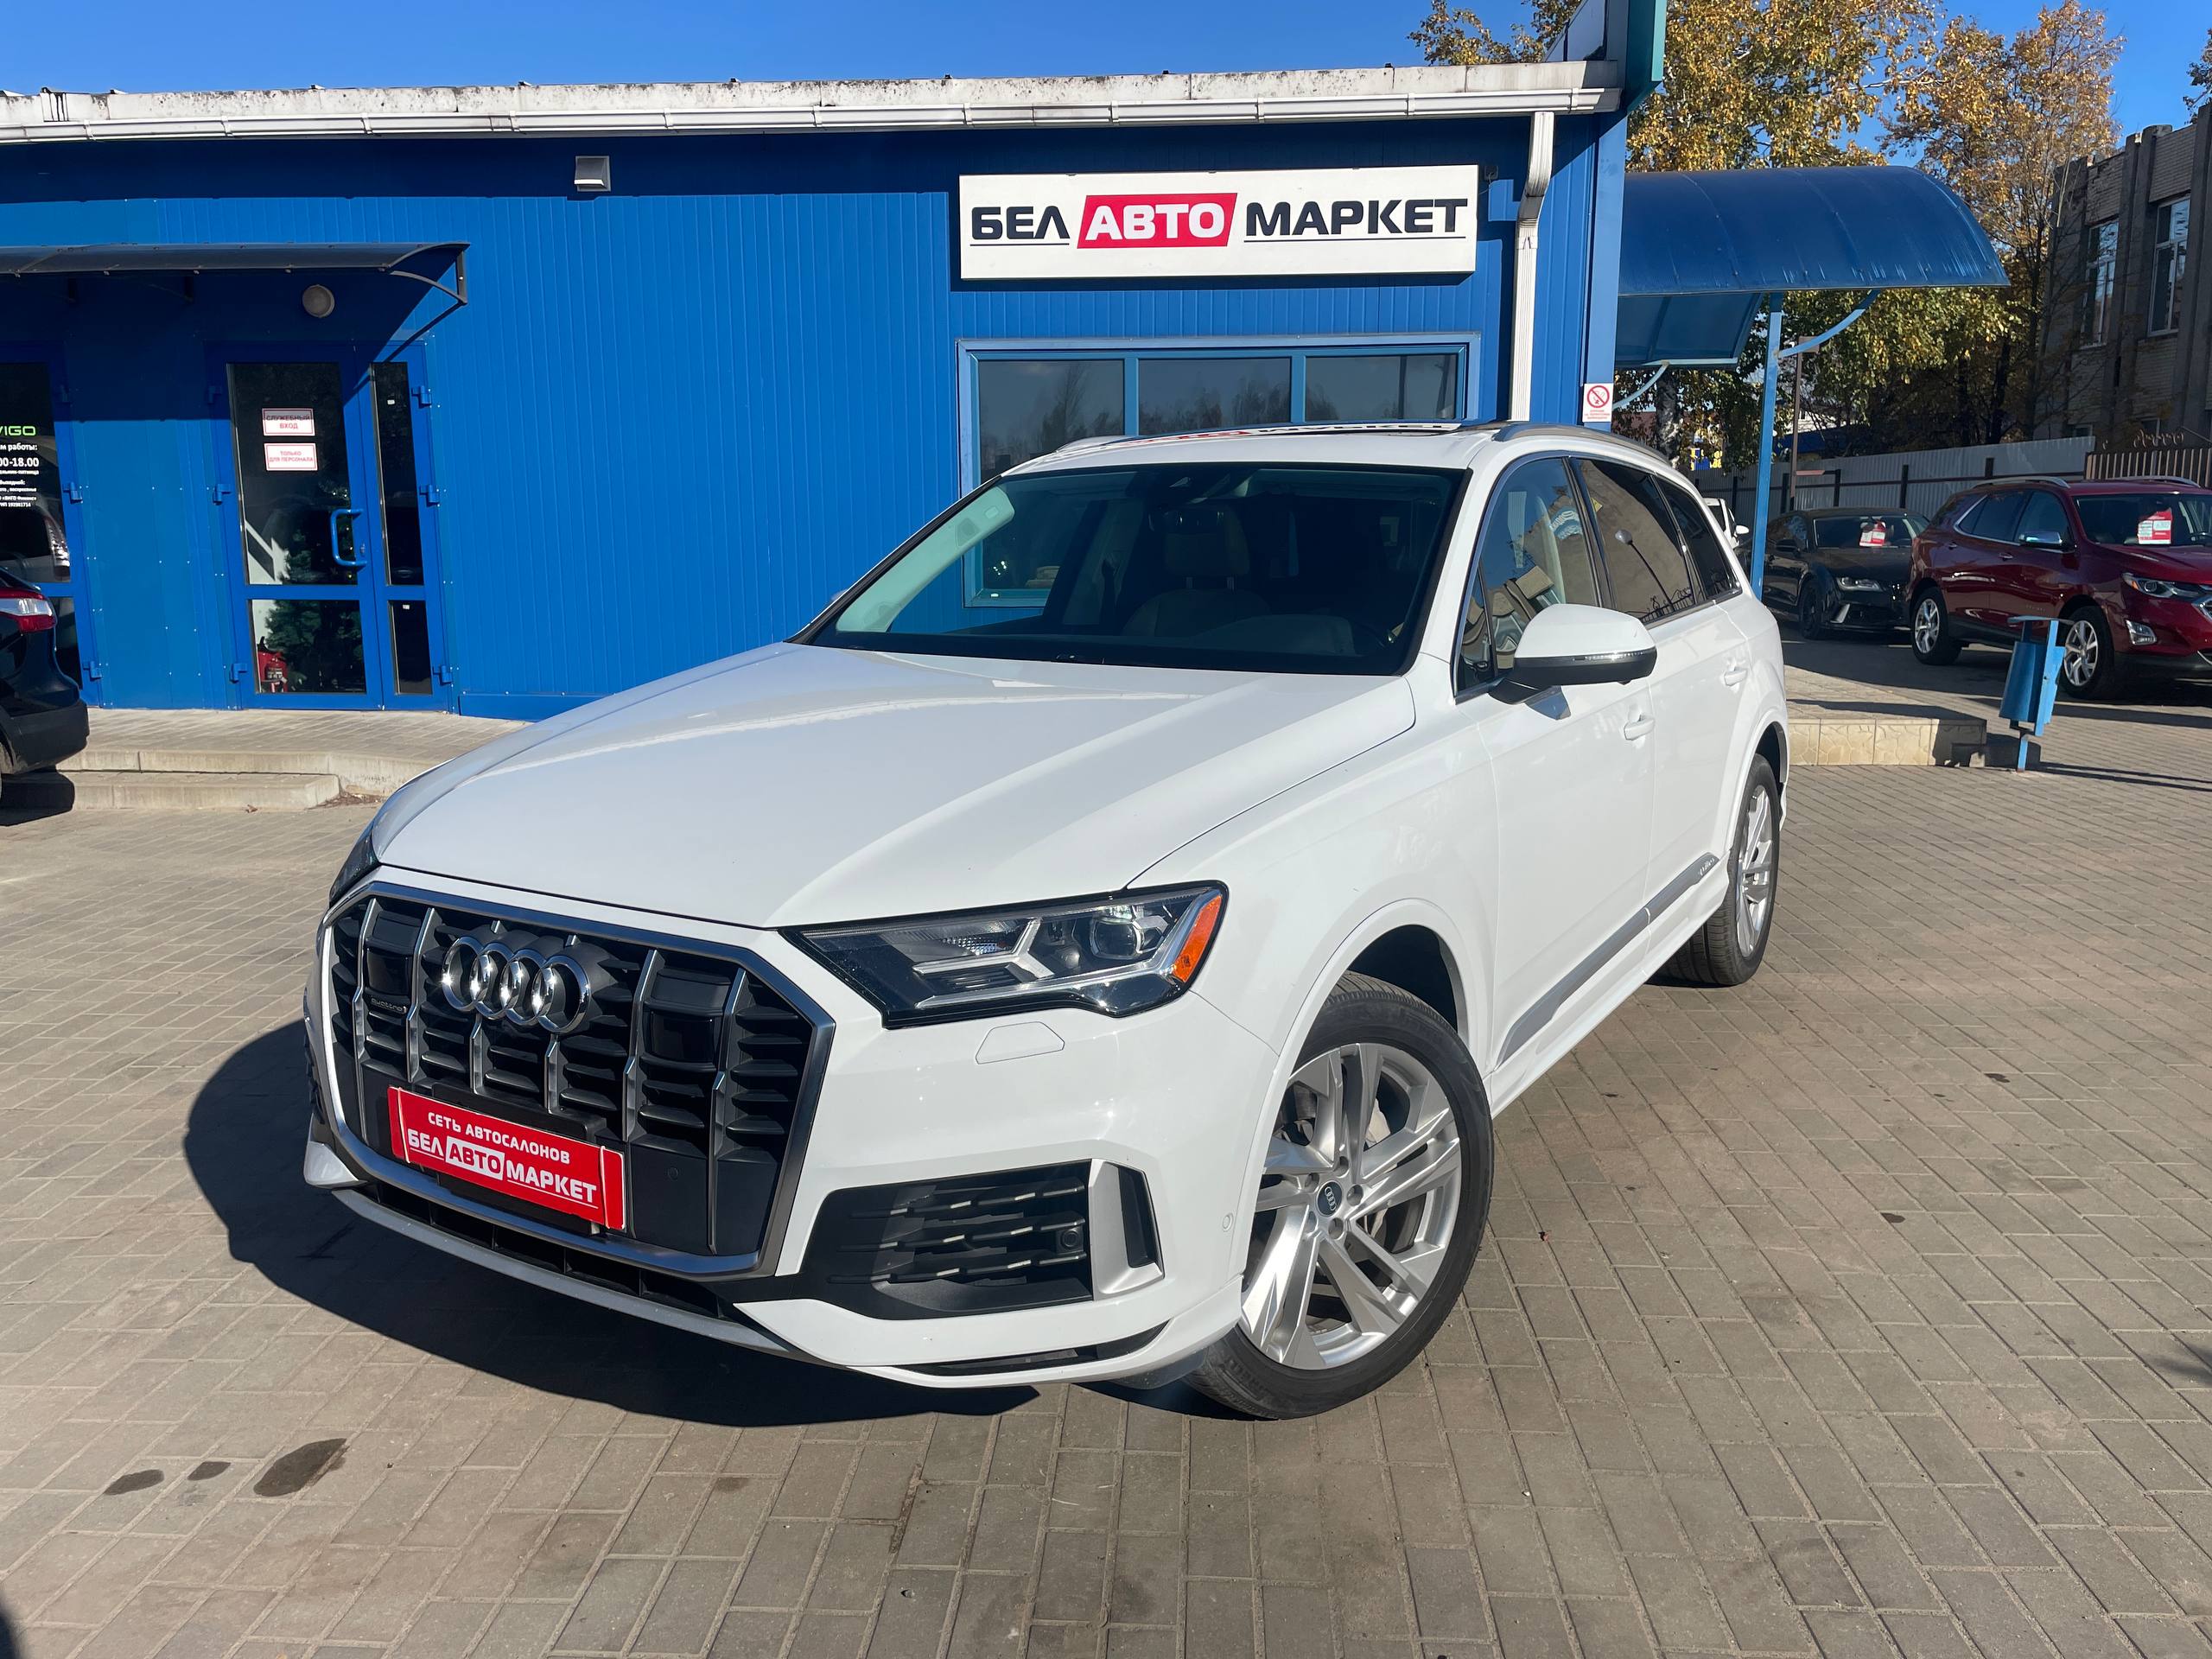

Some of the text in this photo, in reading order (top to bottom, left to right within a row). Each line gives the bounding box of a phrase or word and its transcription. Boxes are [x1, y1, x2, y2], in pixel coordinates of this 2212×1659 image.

[970, 198, 1469, 241] БЕЛ АВТО МАРКЕТ
[0, 426, 36, 435] IGO
[8, 442, 38, 452] работы:
[428, 1111, 570, 1165] СЕТЬ АВТОСАЛОНОВ
[407, 1128, 597, 1204] БЕЛ АВТО МАРКЕТ
